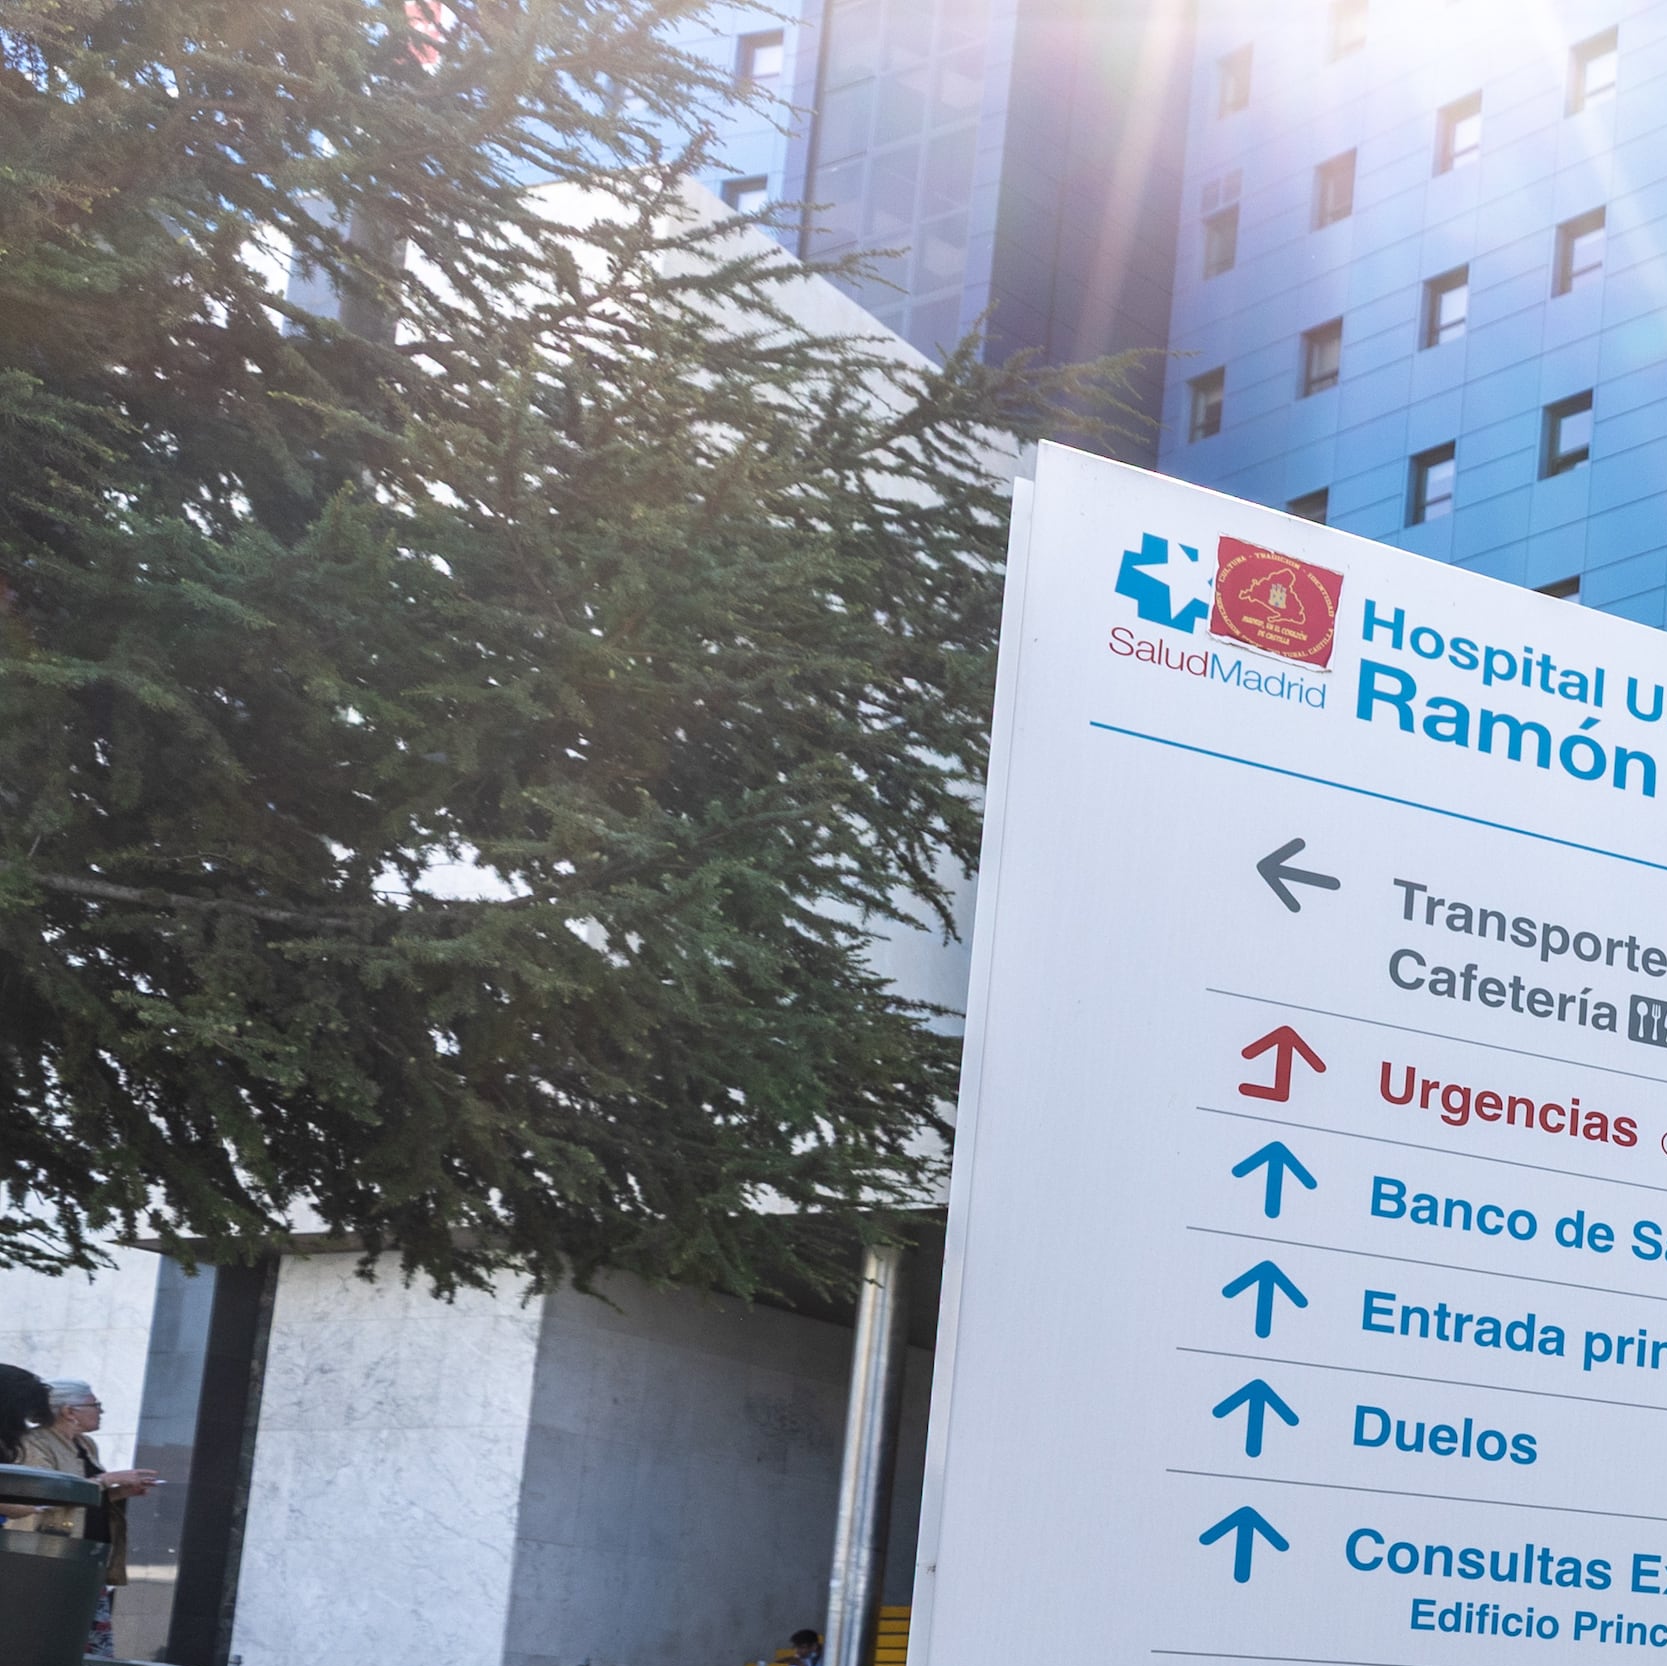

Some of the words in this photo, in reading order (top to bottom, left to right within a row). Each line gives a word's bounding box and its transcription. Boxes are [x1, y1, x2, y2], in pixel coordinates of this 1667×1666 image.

[1109, 626, 1326, 709] SaludMadrid
[1362, 599, 1605, 708] Hospital
[1356, 658, 1656, 798] Ramón
[1394, 878, 1667, 977] Transporte
[1389, 949, 1617, 1032] Cafetería
[1380, 1061, 1637, 1147] Urgencias
[1371, 1175, 1537, 1241] Banco
[1555, 1210, 1615, 1253] de
[1362, 1289, 1565, 1357] Entrada
[1353, 1405, 1537, 1465] Duelos
[1346, 1528, 1612, 1590] Consultas
[1411, 1598, 1559, 1640] Edificio
